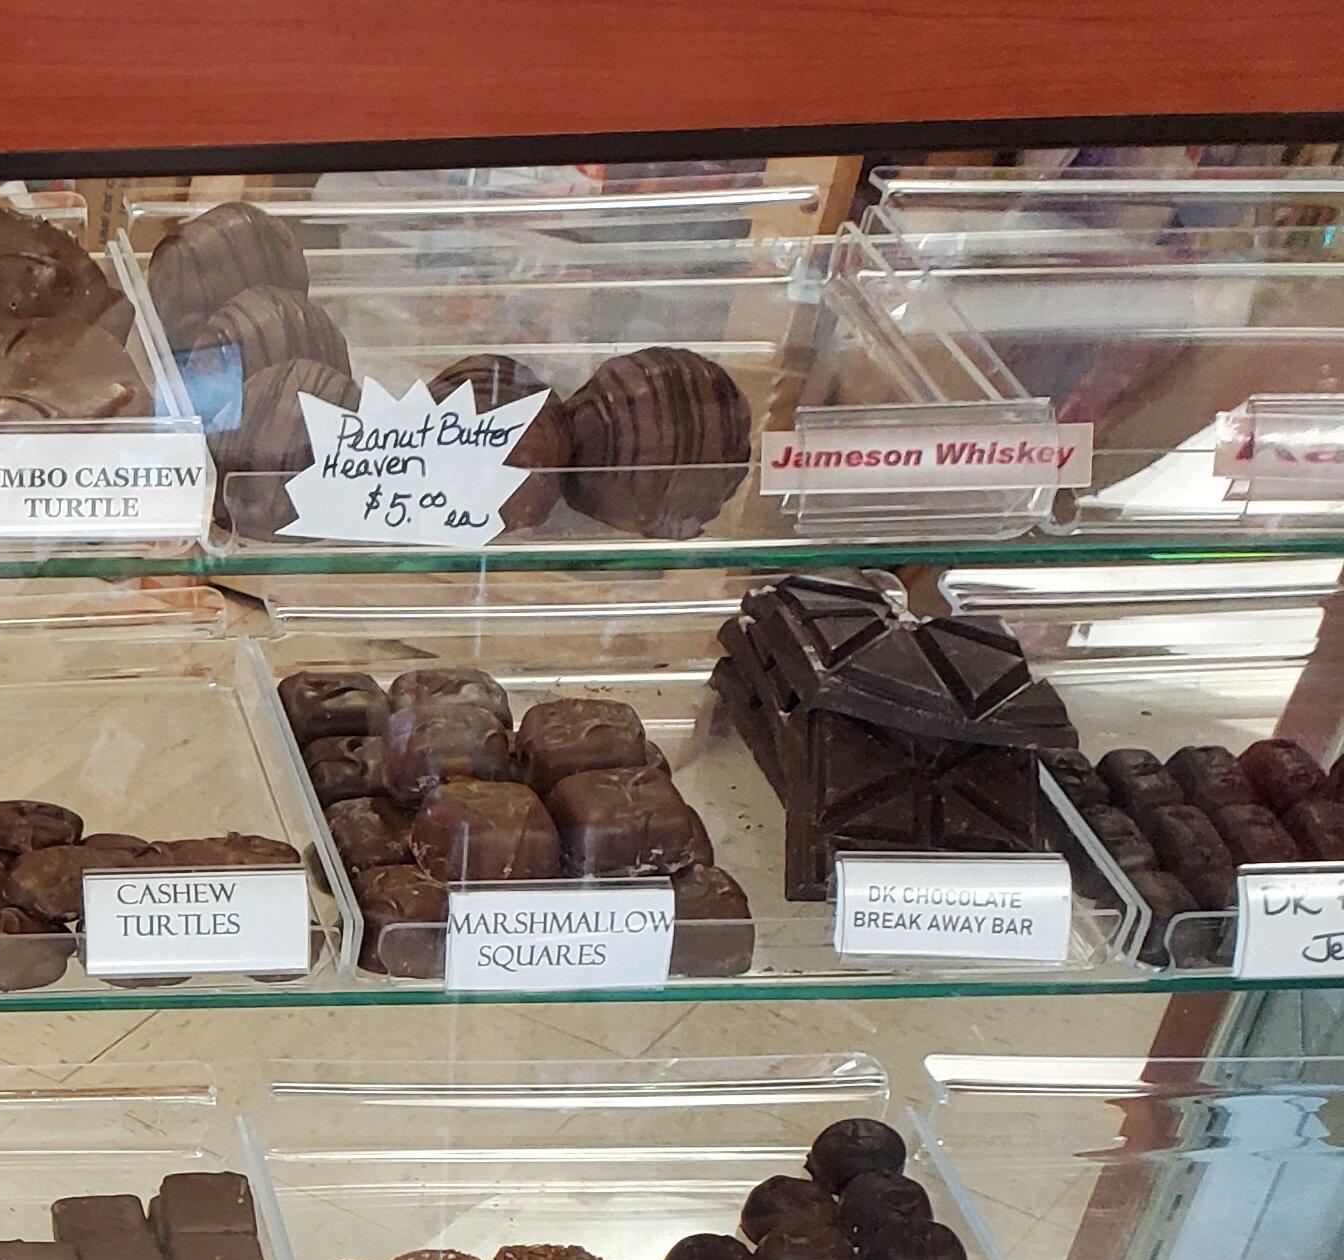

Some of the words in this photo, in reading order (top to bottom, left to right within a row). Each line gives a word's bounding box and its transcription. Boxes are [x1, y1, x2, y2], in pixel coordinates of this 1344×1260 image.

[337, 413, 434, 453] Peanut
[437, 412, 525, 447] Butter
[323, 451, 426, 479] Heaven
[771, 445, 922, 471] Jameson
[936, 441, 1076, 470] Whiskey
[75, 466, 203, 488] CASHEW
[24, 497, 139, 519] TURTLE
[116, 883, 236, 905] CASHEW
[868, 885, 896, 903] DK
[904, 887, 1022, 909] CHOCOLATE
[117, 913, 241, 937] TURTLES
[448, 911, 673, 936] MARSHMALLOW
[853, 911, 921, 930] BREAK
[927, 914, 984, 934] AWAY
[991, 916, 1033, 936] BAR
[477, 944, 607, 970] SQUARES
